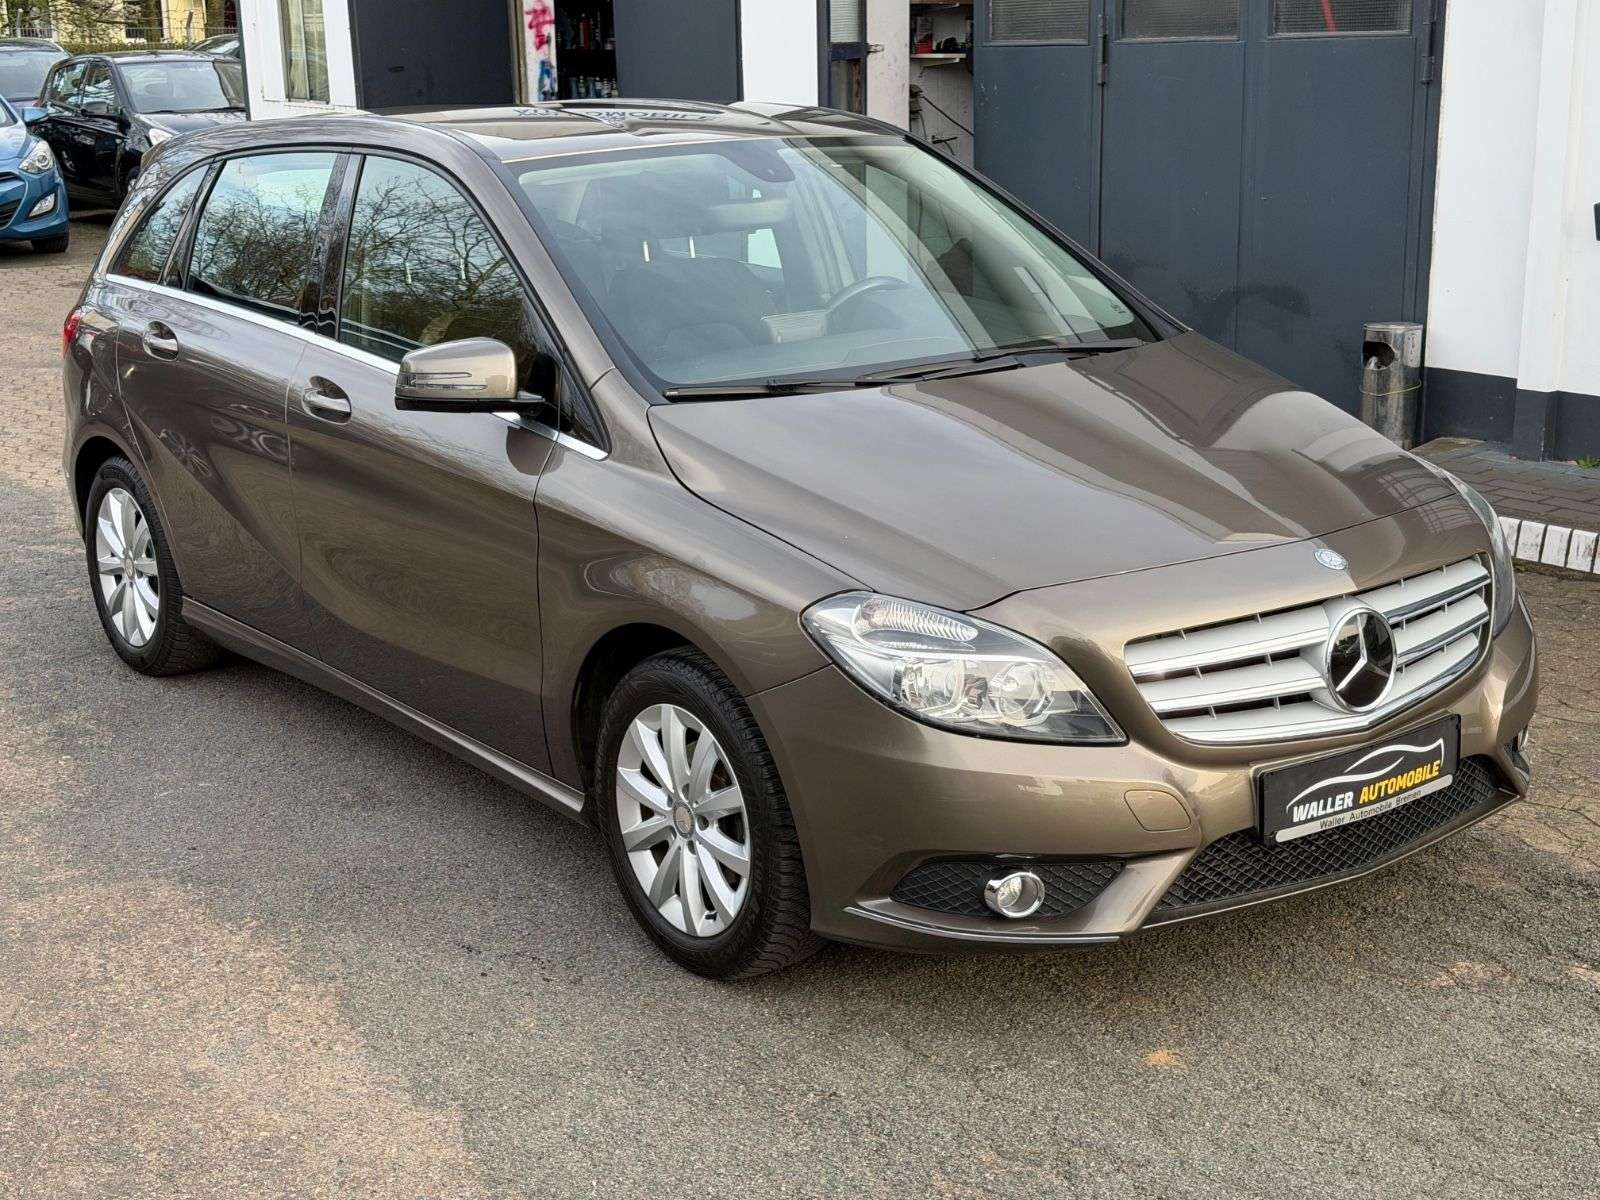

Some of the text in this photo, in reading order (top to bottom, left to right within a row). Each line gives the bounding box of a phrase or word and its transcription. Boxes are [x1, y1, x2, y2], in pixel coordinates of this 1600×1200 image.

[1293, 759, 1441, 822] WALLER AUTOMOBILE
[1350, 801, 1392, 821] Automobile
